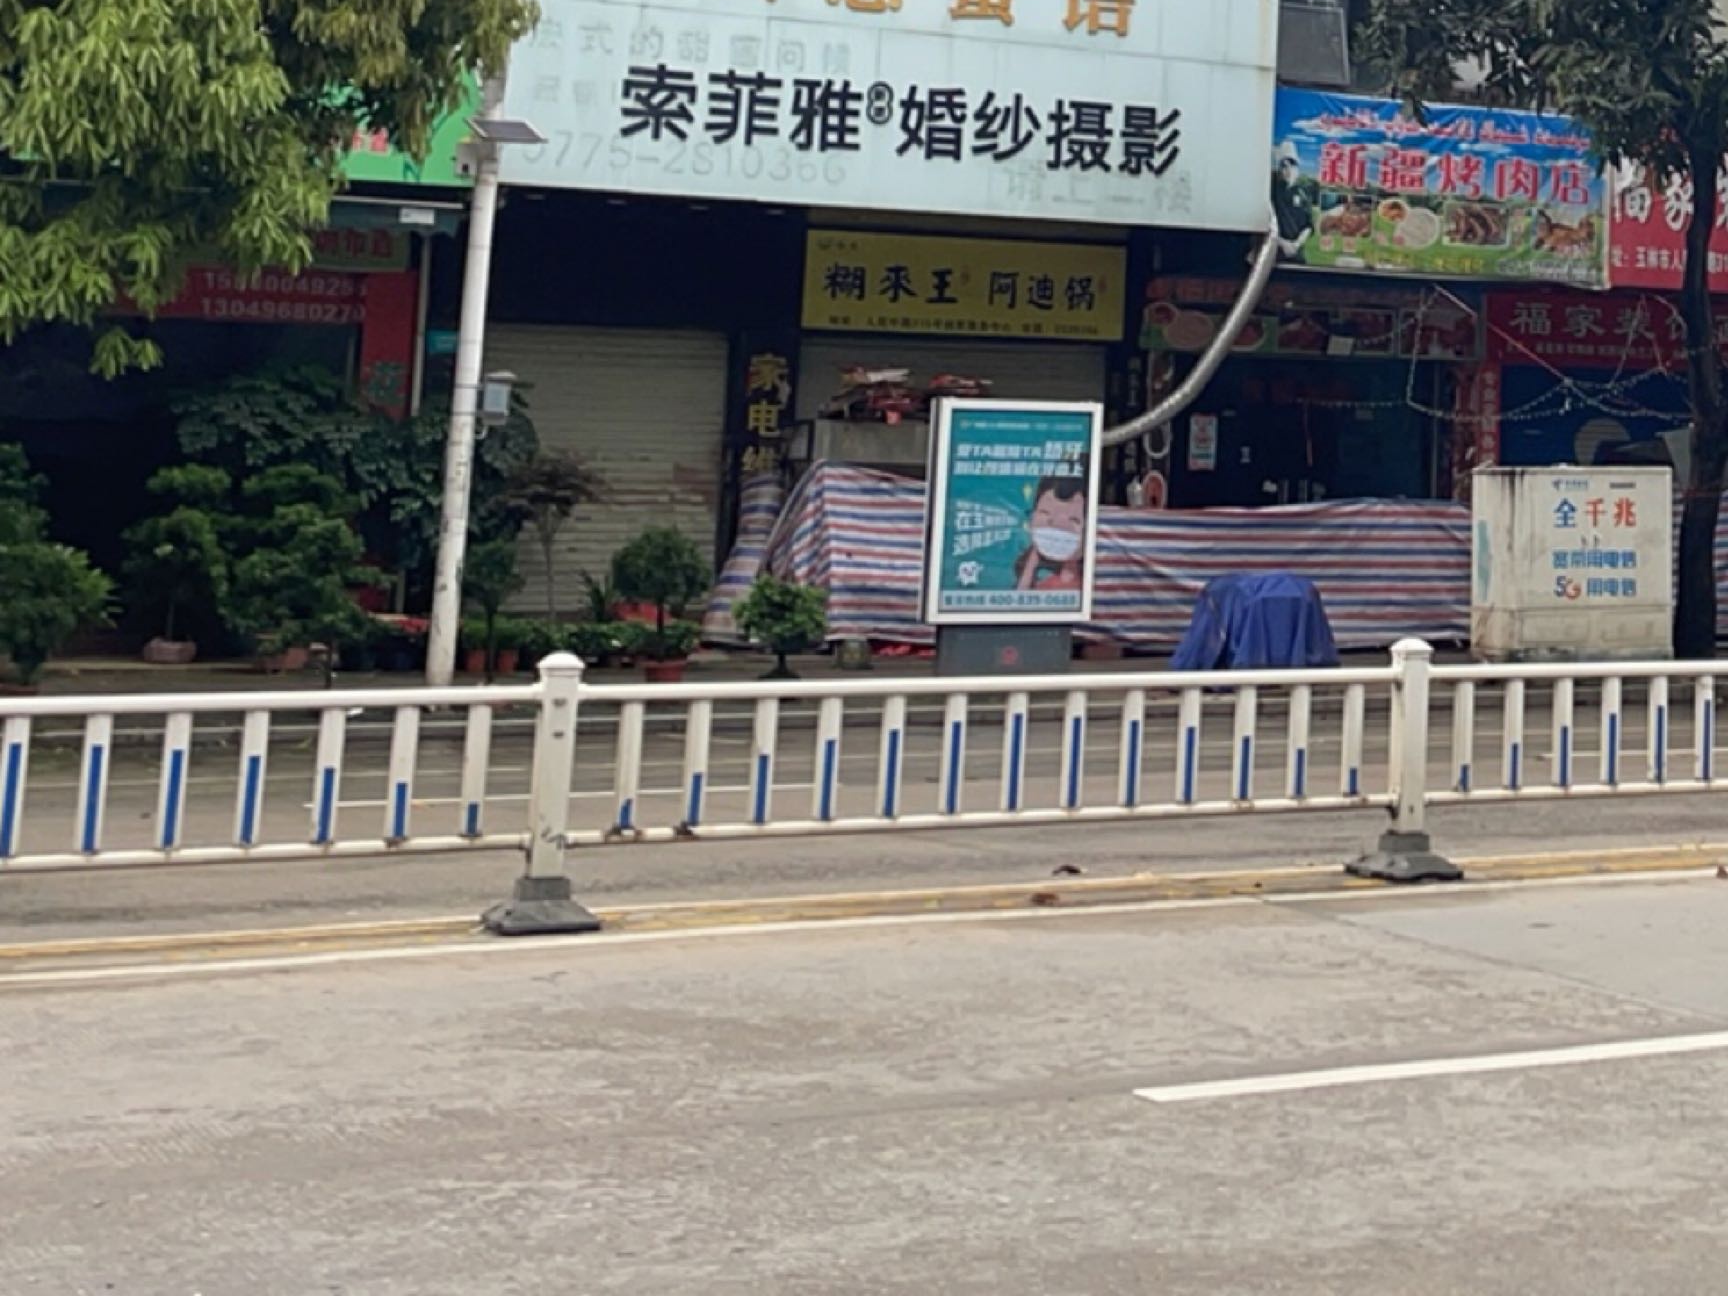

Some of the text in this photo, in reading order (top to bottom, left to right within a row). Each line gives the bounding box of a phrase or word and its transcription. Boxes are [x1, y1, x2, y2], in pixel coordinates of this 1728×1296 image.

[618, 62, 866, 154] 索菲雅
[895, 84, 1184, 177] 婚纱摄影
[1319, 142, 1589, 205] 新疆烤肉店
[1553, 497, 1637, 529] 全千兆
